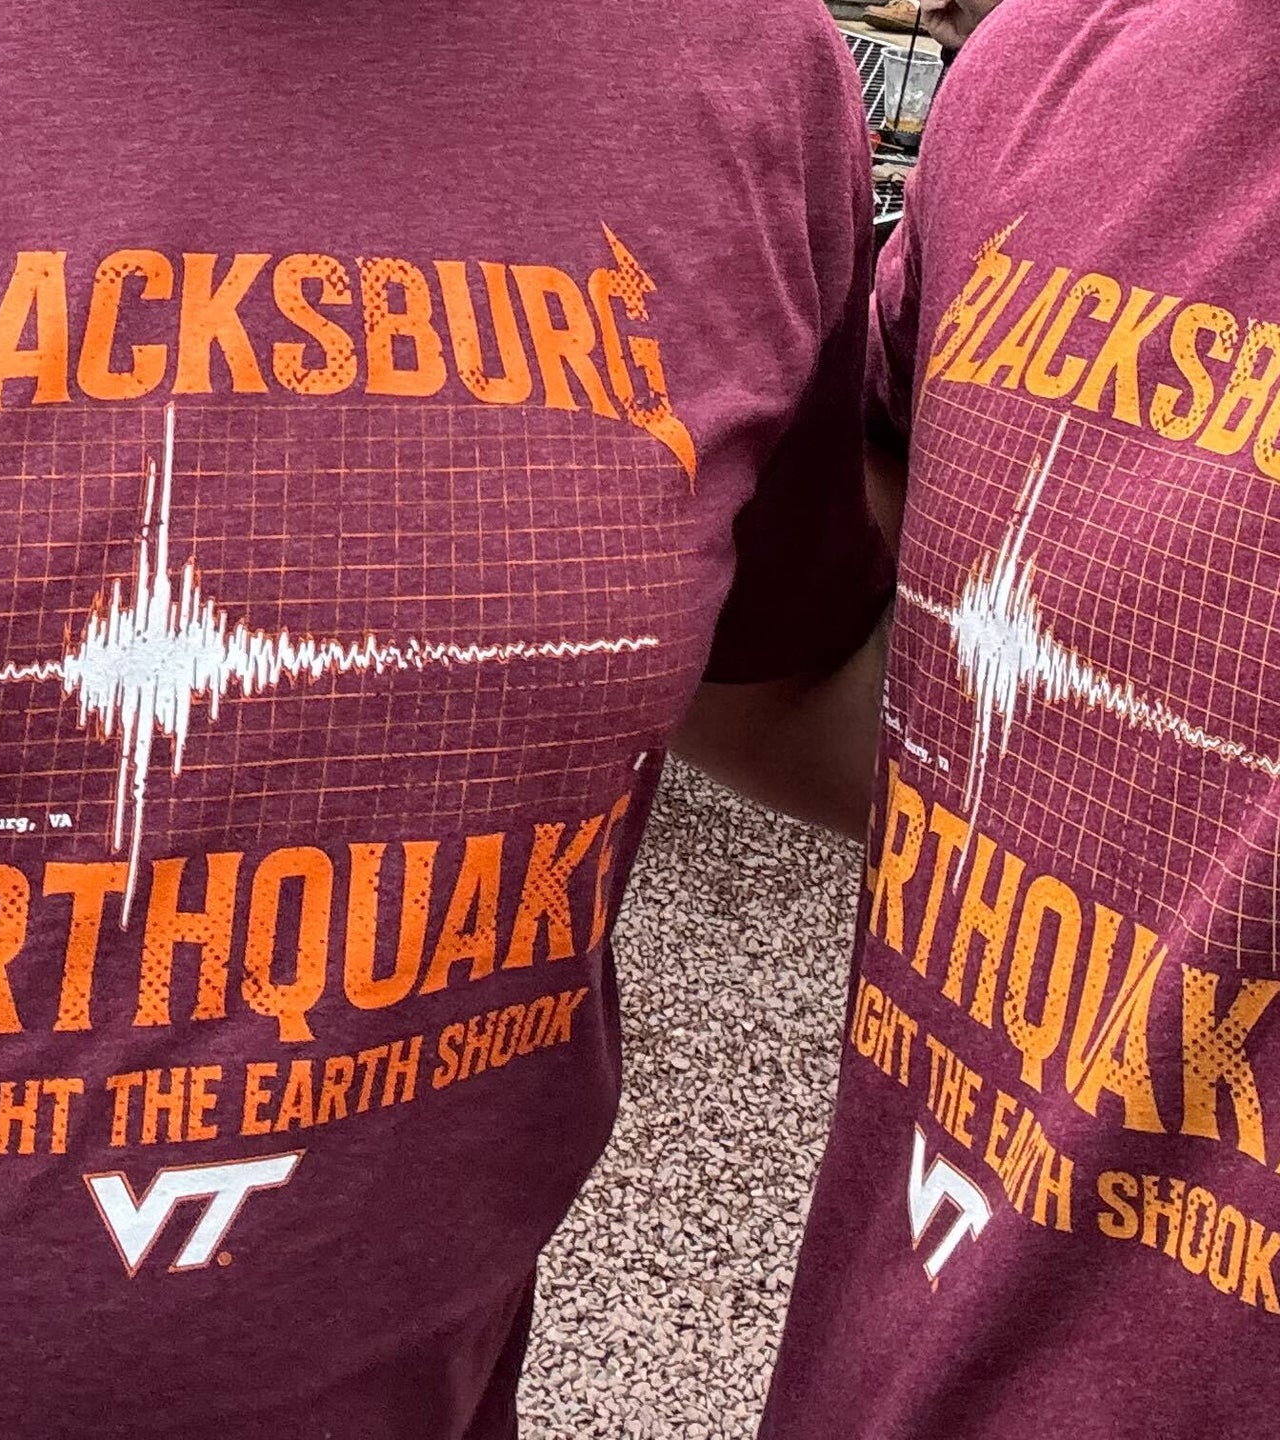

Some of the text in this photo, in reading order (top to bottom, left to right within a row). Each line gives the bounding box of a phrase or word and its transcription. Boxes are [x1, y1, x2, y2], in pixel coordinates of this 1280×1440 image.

[48, 812, 73, 828] VA
[106, 1061, 223, 1147] THE
[239, 1036, 423, 1137] EARTH
[431, 987, 590, 1091] SHOOK
[849, 973, 920, 1090] IGHT
[923, 1033, 984, 1150] THE
[81, 1148, 308, 1280] VT
